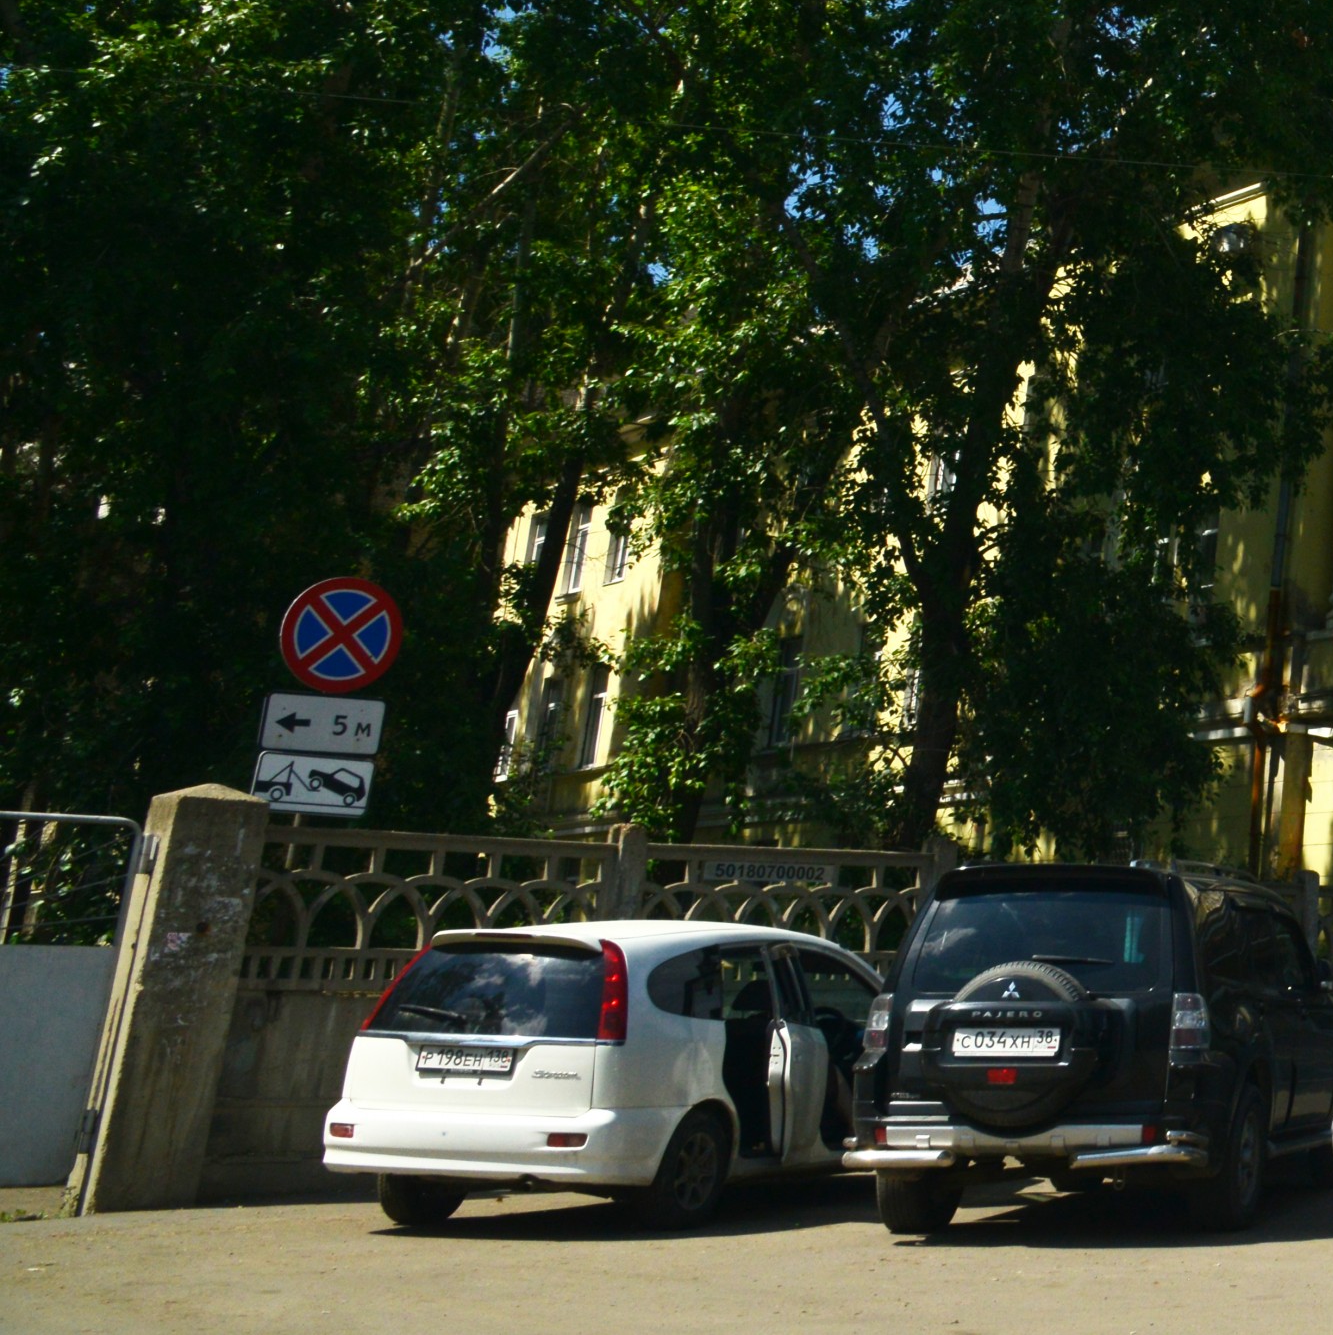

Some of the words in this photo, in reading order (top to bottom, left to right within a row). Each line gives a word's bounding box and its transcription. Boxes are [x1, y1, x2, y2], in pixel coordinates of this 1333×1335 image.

[332, 714, 349, 736] 5
[714, 863, 826, 881] 50180700002
[970, 1010, 1044, 1018] PAJERO
